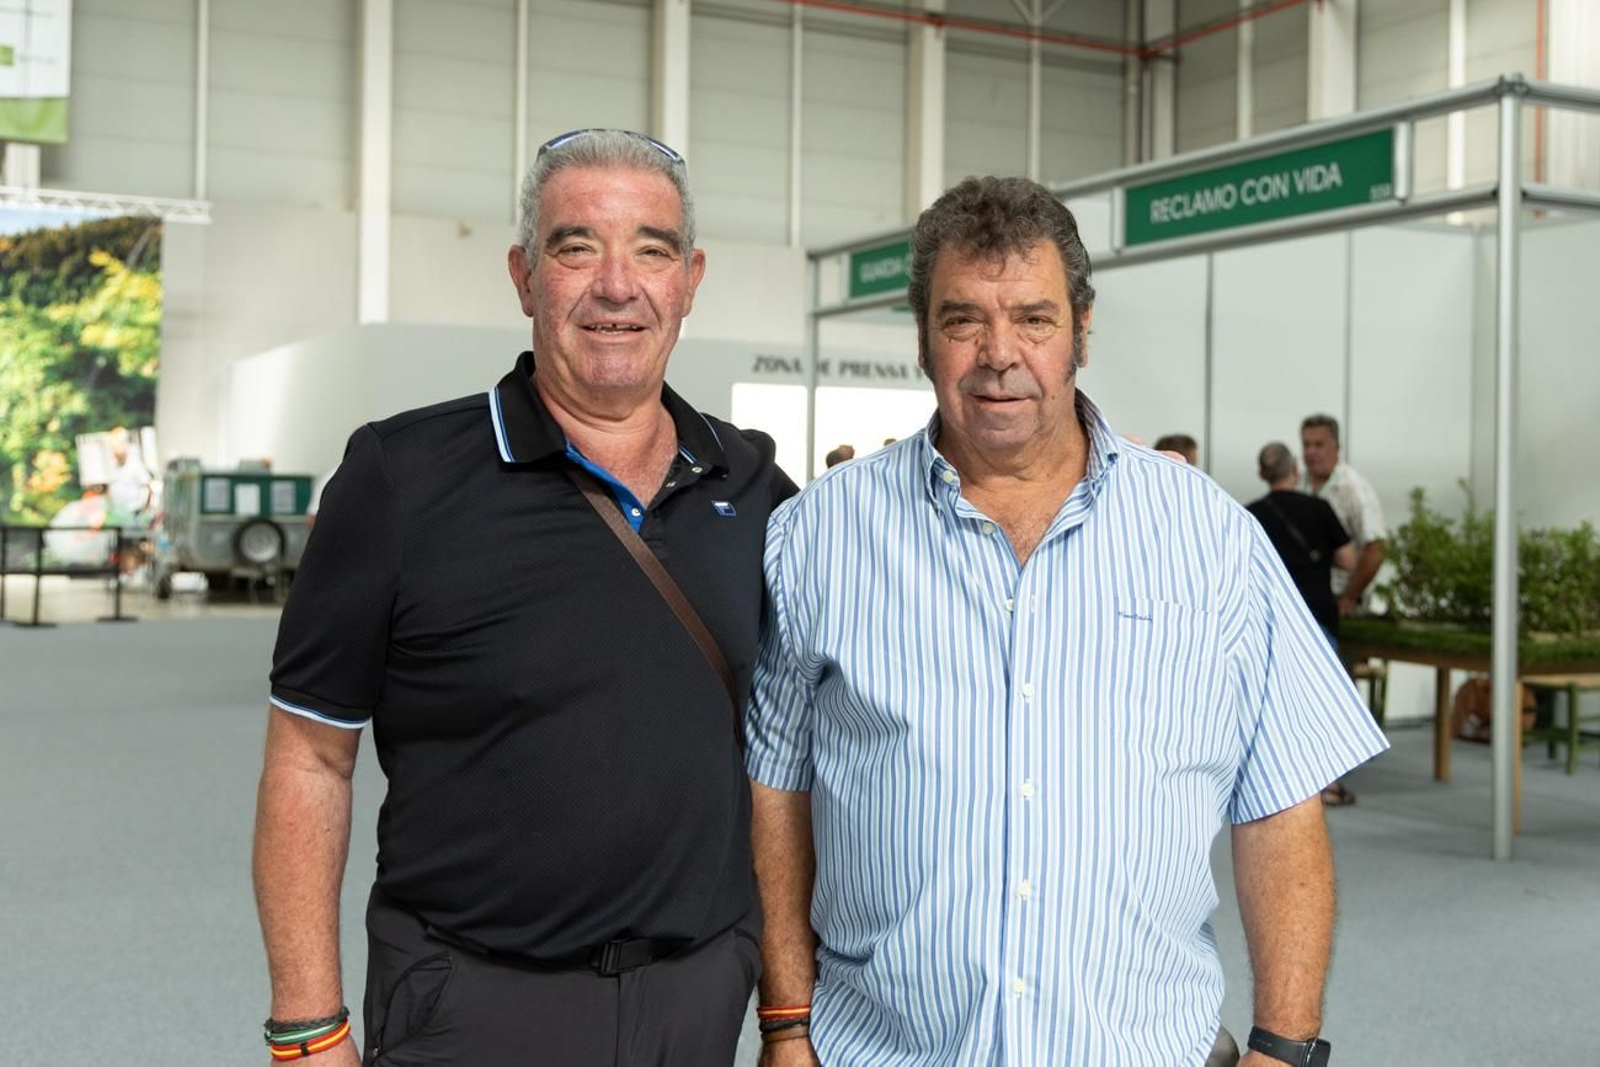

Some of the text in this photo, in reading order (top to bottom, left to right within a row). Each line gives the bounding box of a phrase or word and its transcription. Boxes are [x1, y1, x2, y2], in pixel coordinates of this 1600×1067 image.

[1150, 184, 1237, 223] RECLAMO
[1241, 173, 1290, 205] CON
[1293, 162, 1342, 194] VIDA
